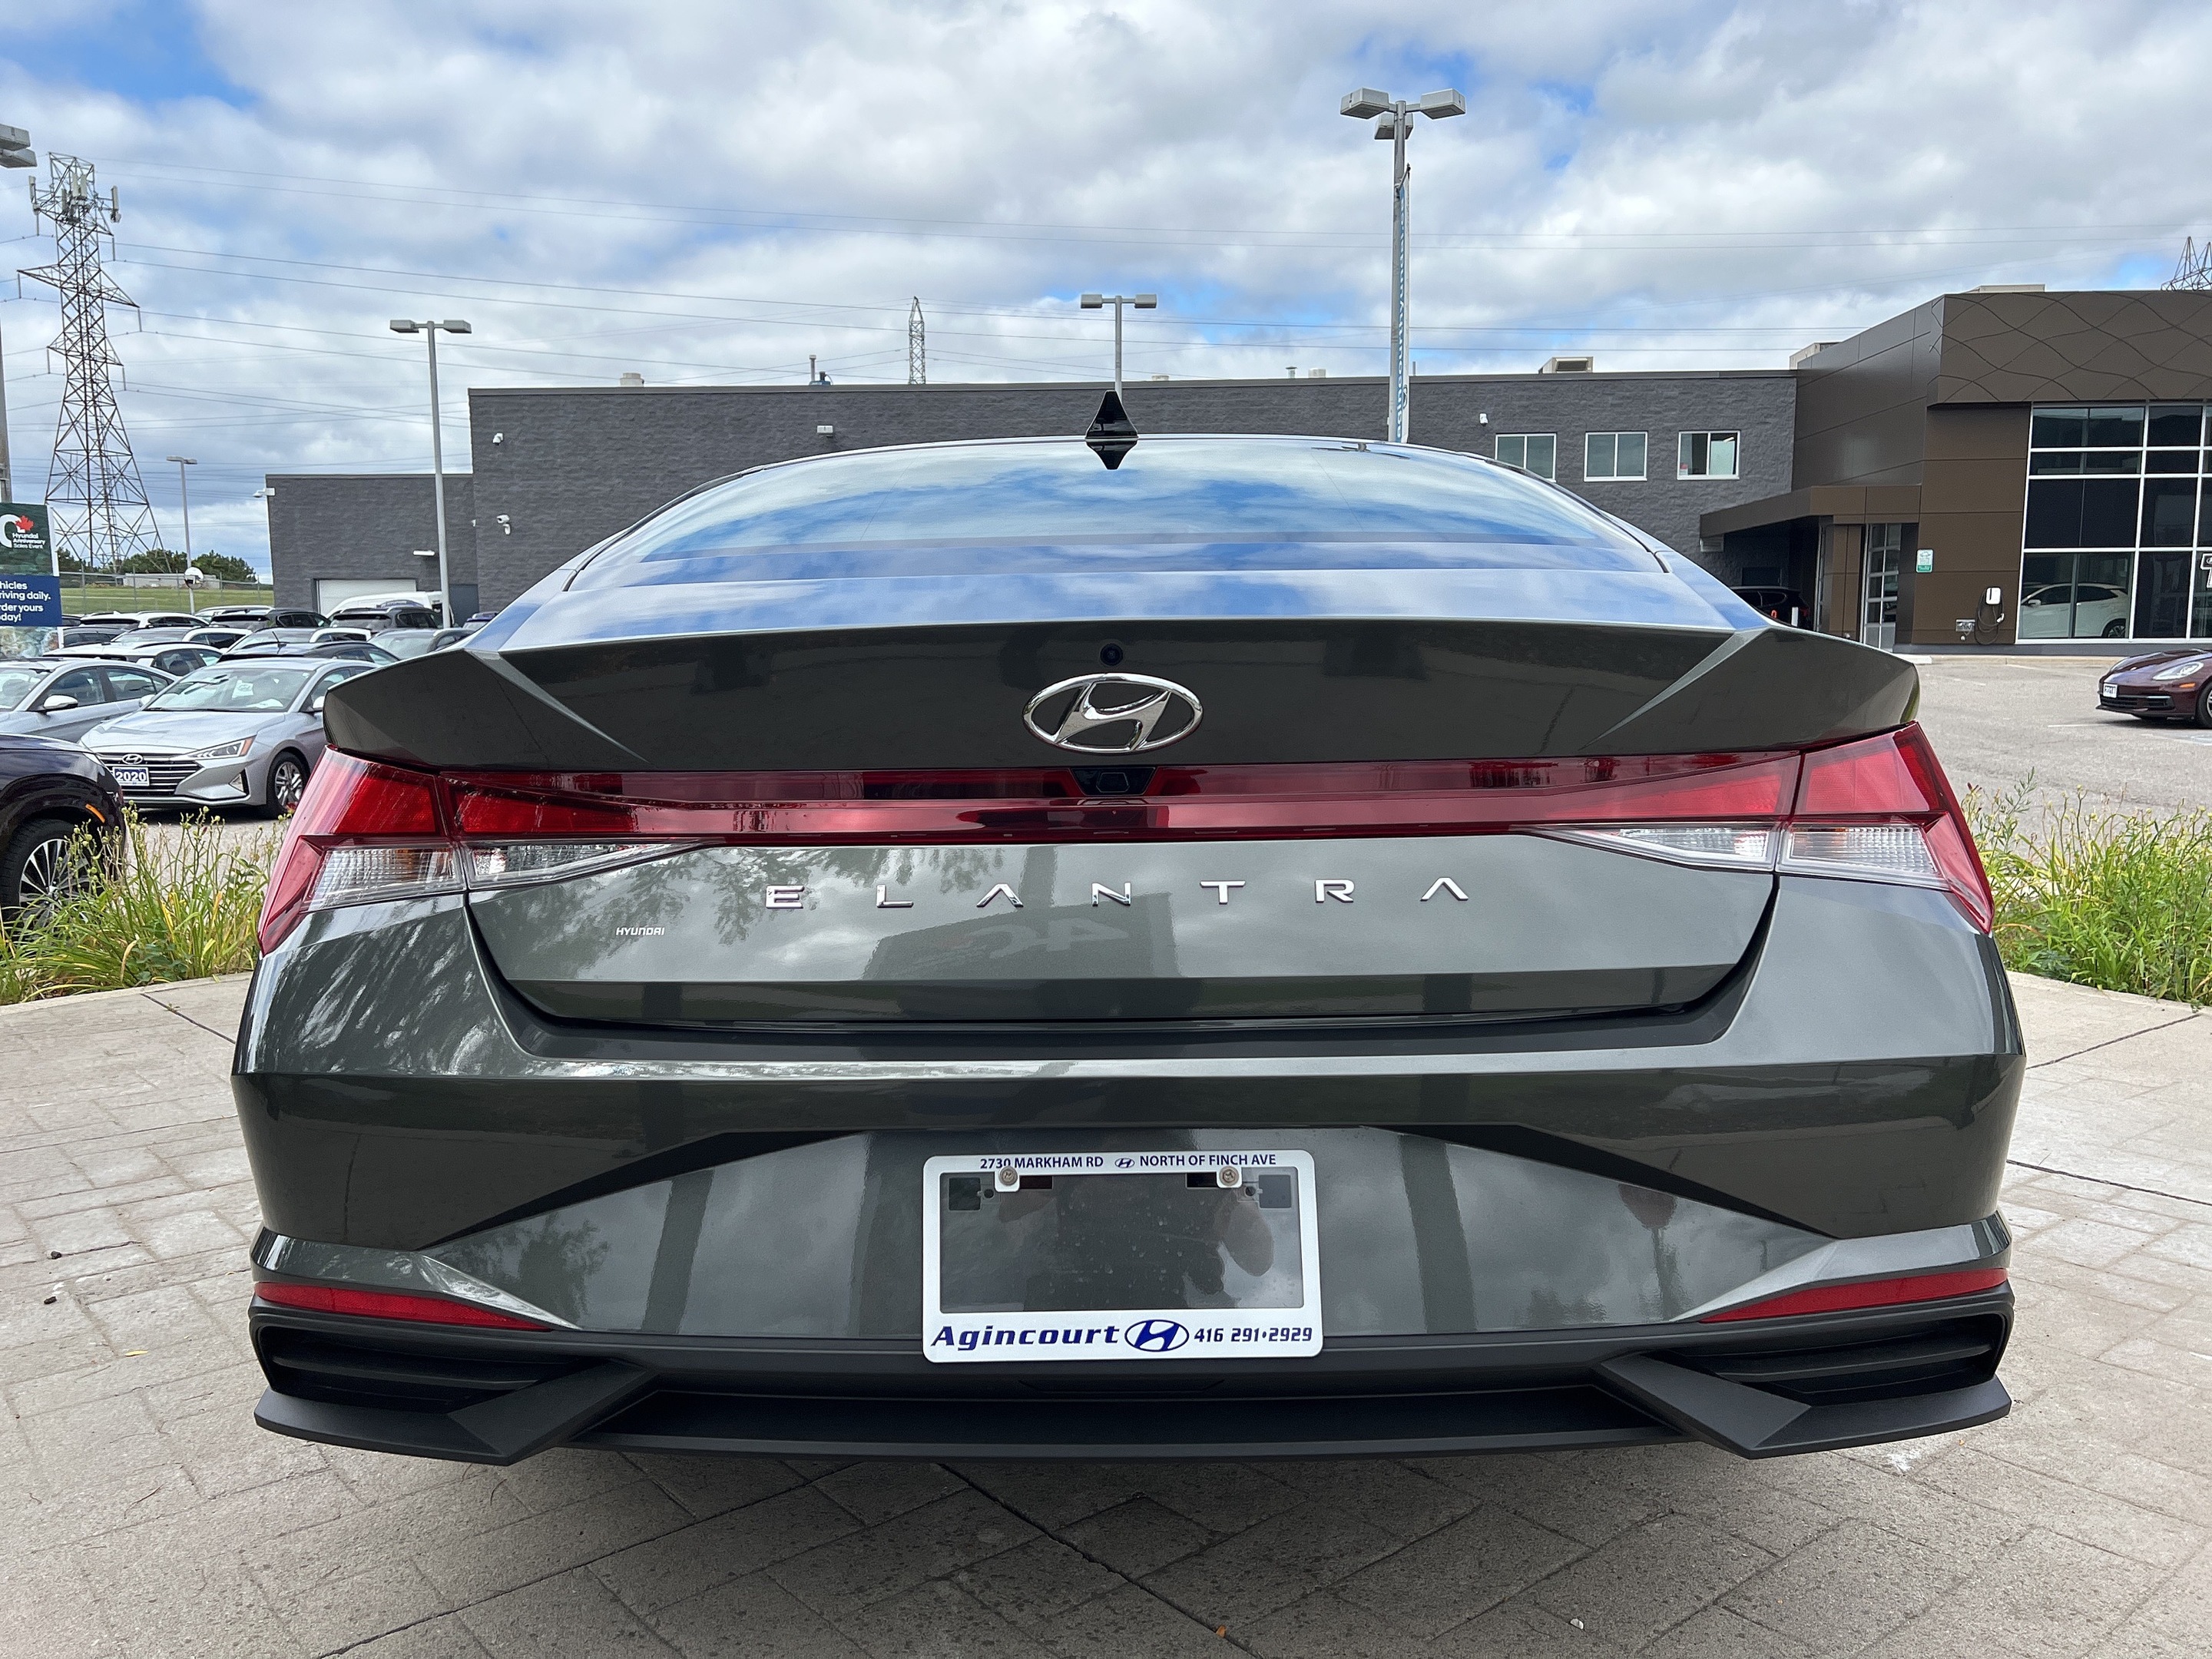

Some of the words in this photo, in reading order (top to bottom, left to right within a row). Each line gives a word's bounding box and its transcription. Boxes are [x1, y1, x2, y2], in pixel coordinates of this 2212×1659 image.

[26, 591, 51, 601] daily.
[18, 604, 44, 613] yours
[0, 612, 22, 623] day!
[115, 771, 147, 782] 2020
[765, 876, 1469, 910] ELANTRA
[615, 927, 665, 935] HYUNDAI
[980, 1158, 1011, 1168] 2730
[1015, 1157, 1082, 1168] MARKHAM
[1086, 1157, 1104, 1167] RD
[1140, 1155, 1185, 1167] NORTH
[1187, 1155, 1206, 1166] OF
[1209, 1154, 1248, 1165] FINCH
[1251, 1154, 1277, 1165] AVE
[931, 1324, 1121, 1352] Agincourt
[1194, 1327, 1224, 1343] 416
